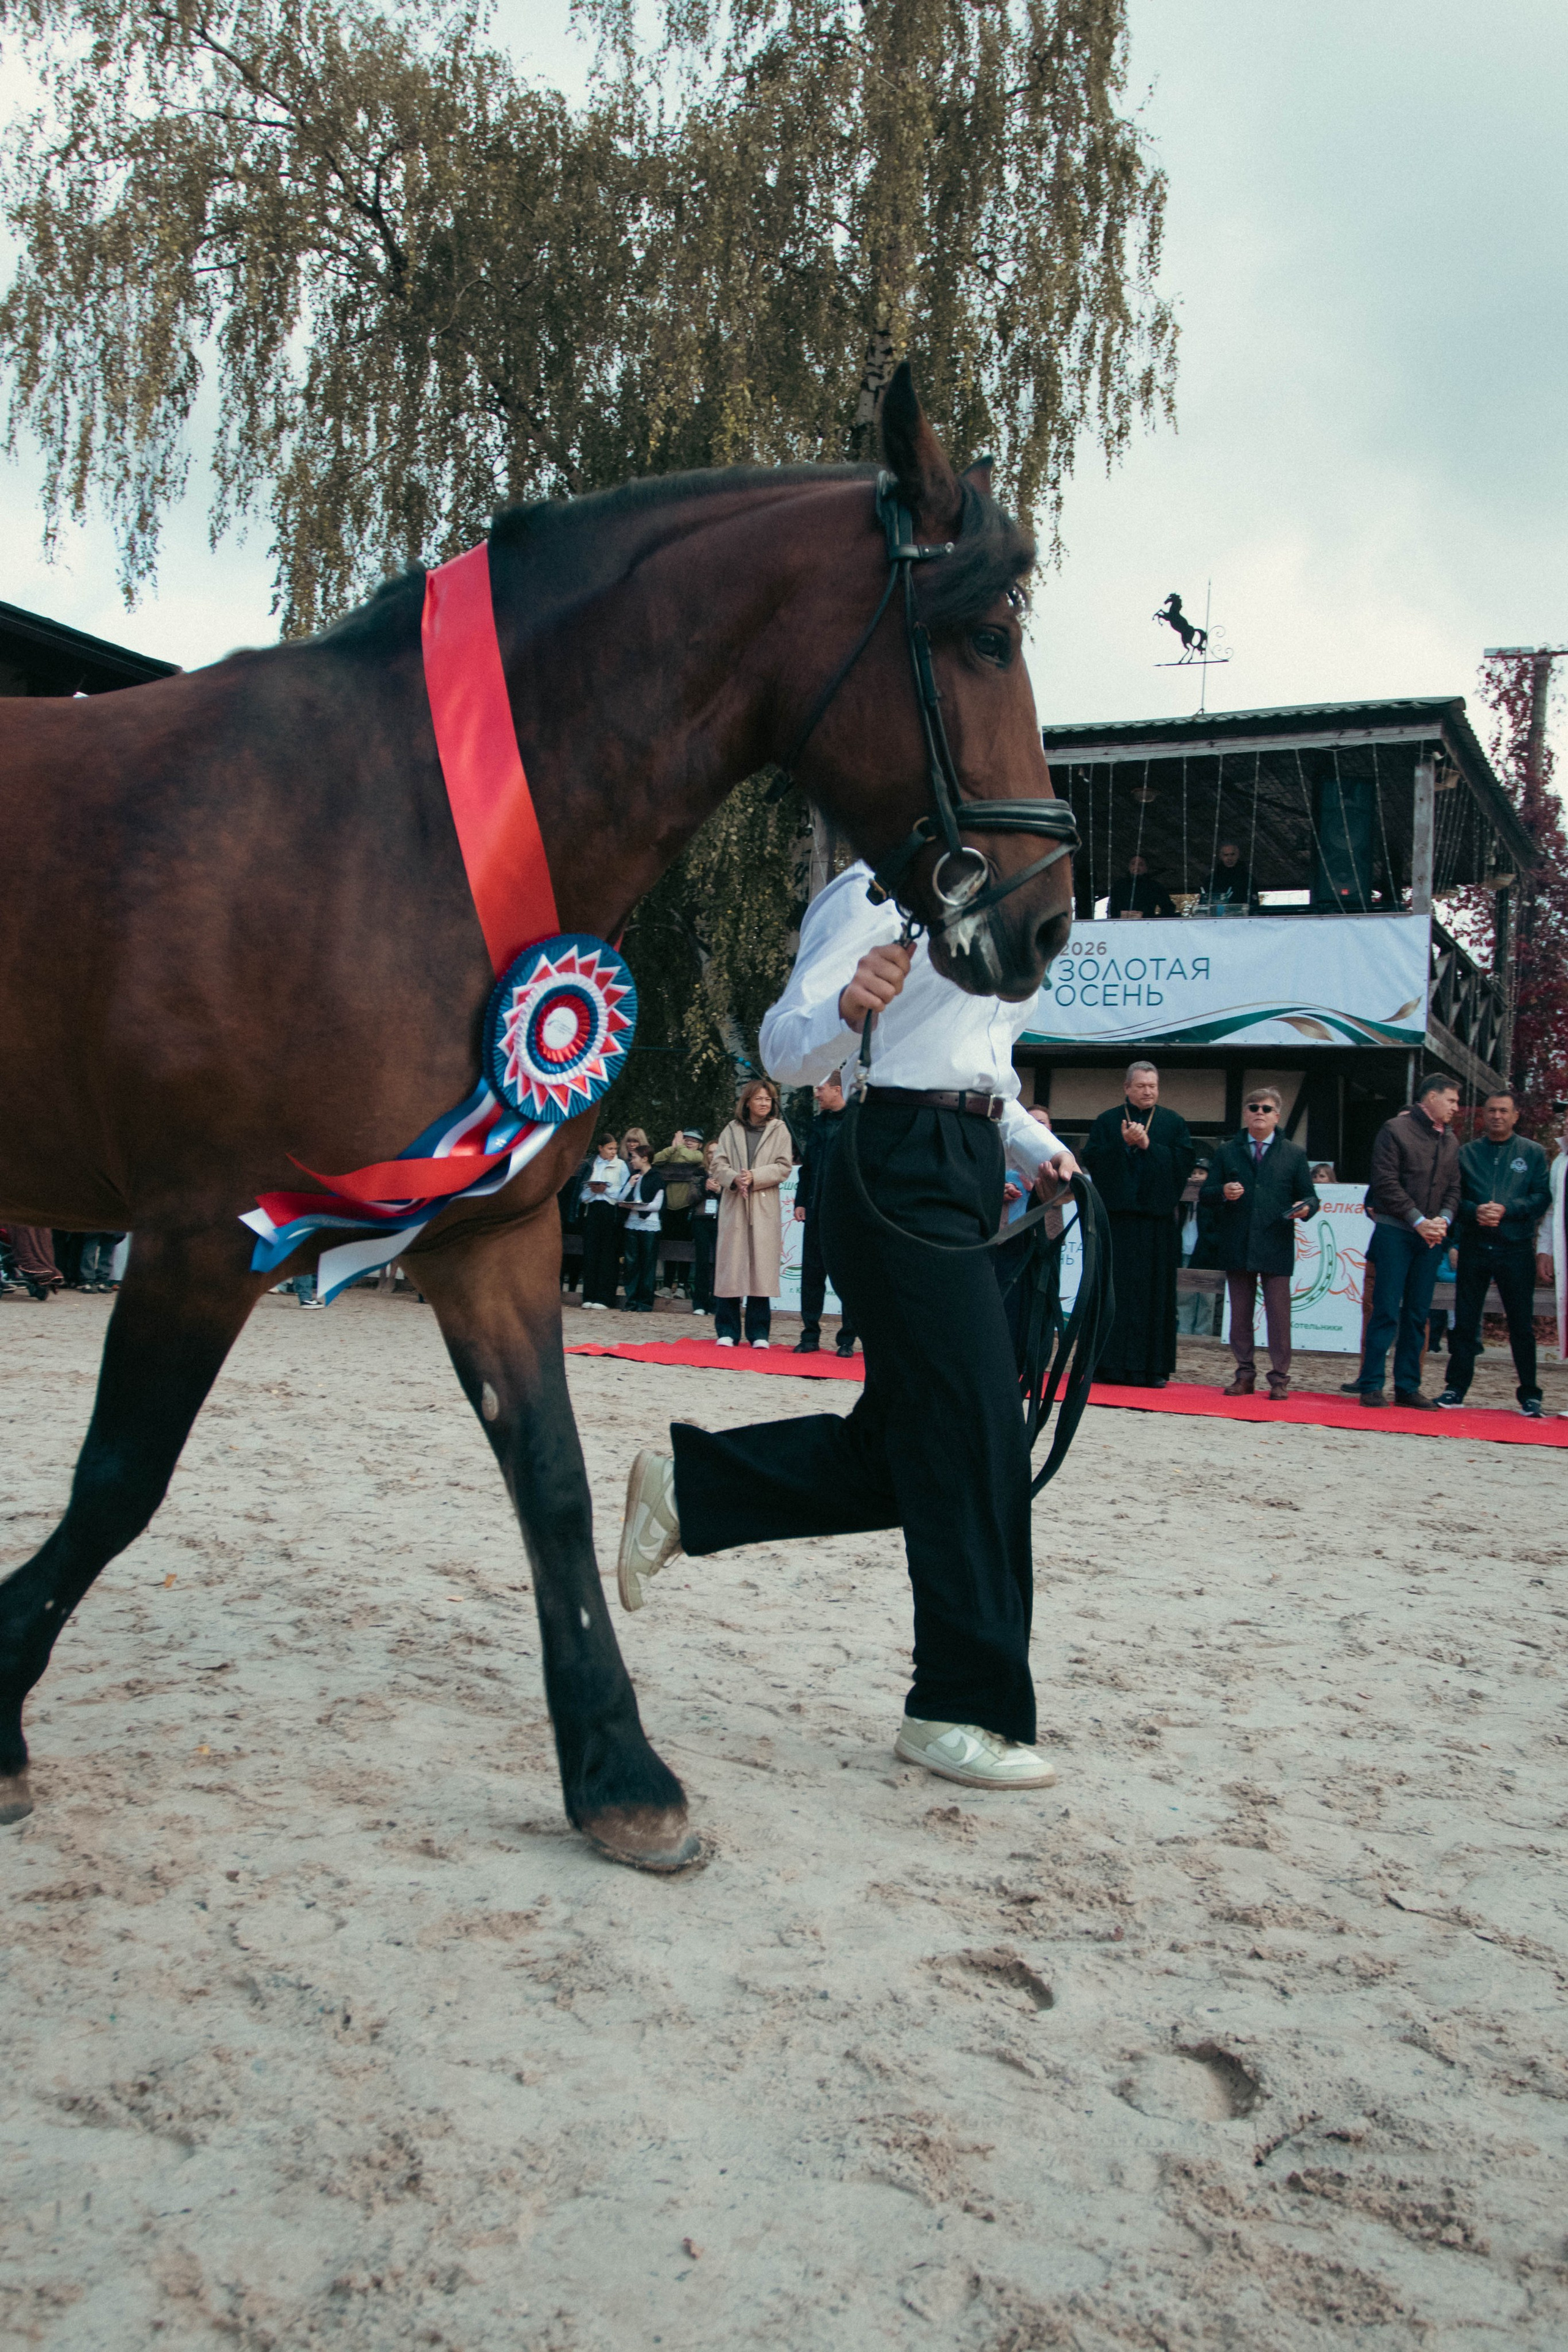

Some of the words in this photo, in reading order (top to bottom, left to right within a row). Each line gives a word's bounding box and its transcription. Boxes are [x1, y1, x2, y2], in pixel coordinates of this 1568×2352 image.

[1059, 941, 1107, 956] 2026
[1058, 957, 1210, 982] ЗОЛОТАЯ
[1055, 984, 1164, 1006] ОСЕНЬ
